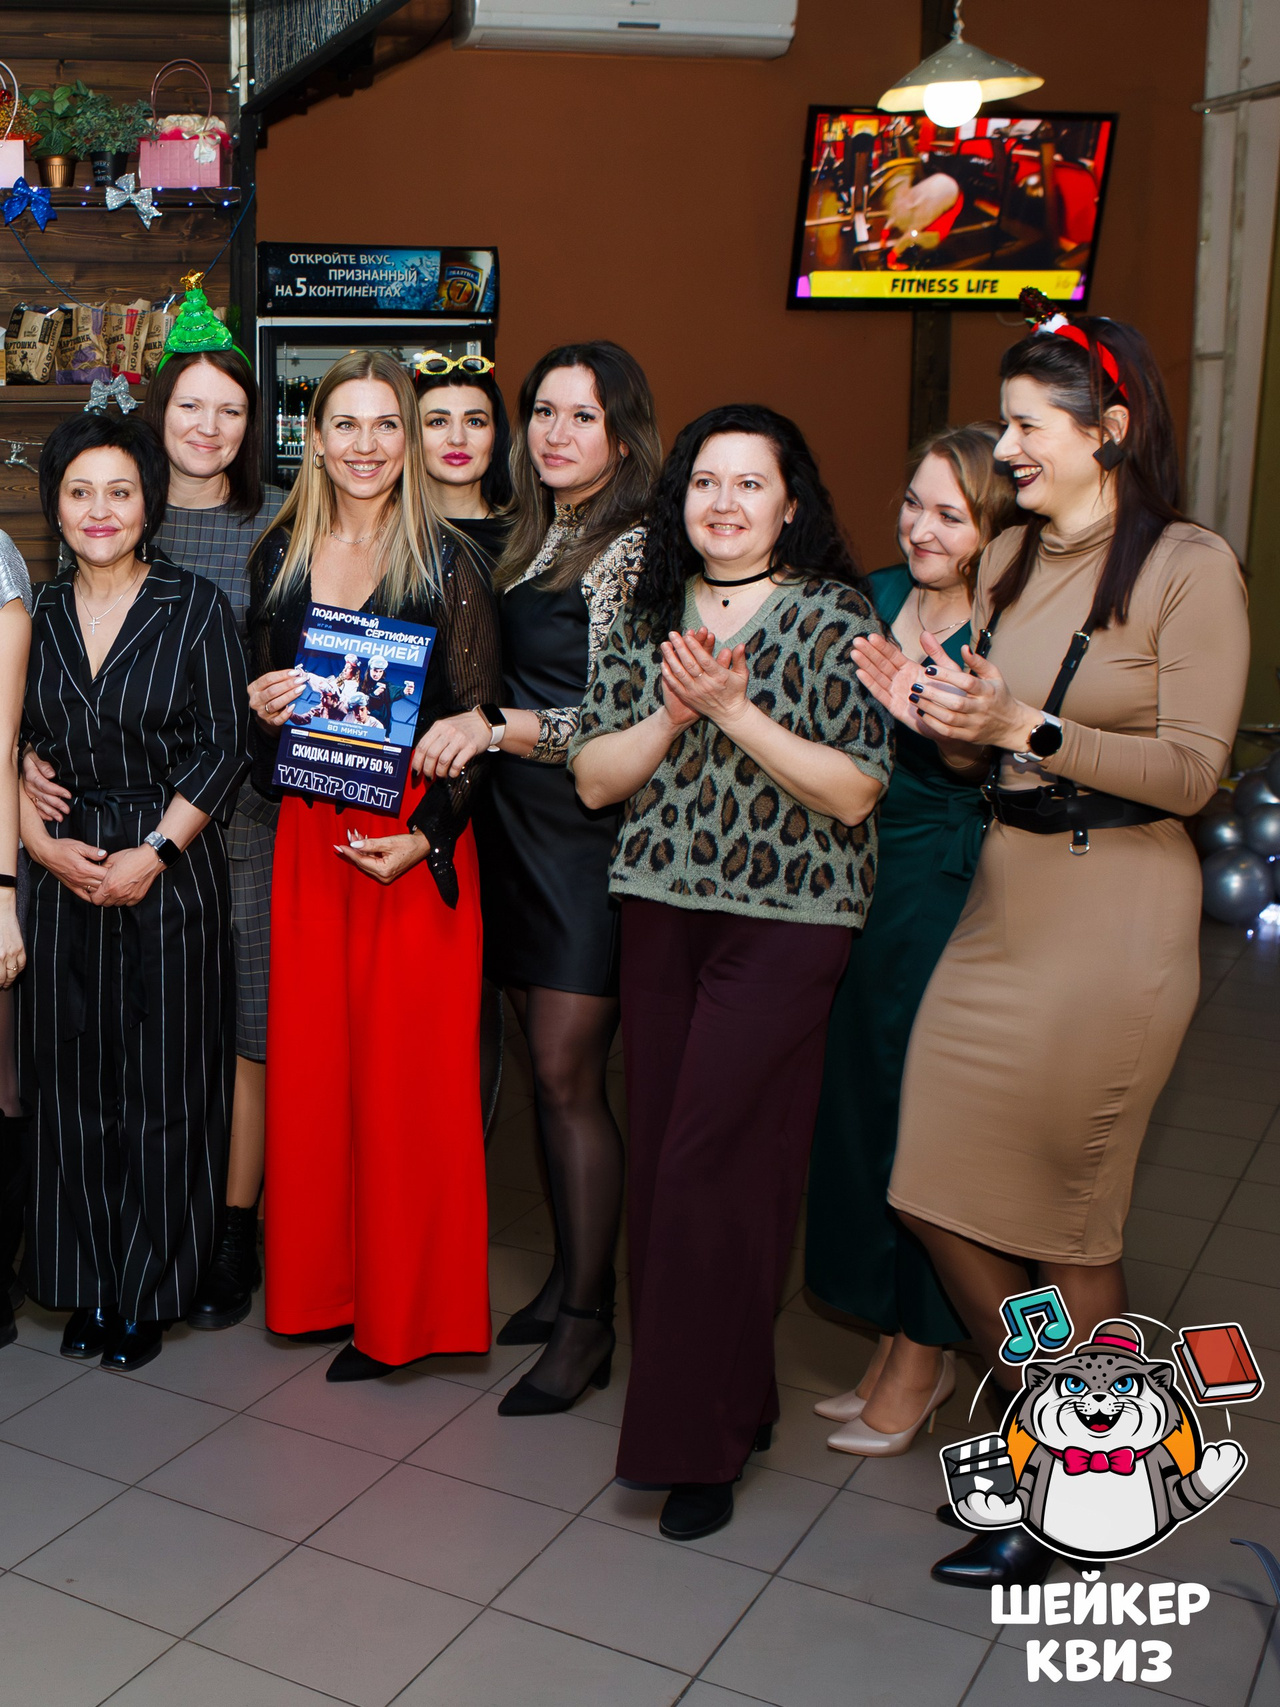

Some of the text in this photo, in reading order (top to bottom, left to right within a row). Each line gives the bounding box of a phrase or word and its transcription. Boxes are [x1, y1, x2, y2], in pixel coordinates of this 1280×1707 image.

[289, 252, 395, 266] ОТКРОЙТЕ ВКУС,
[328, 267, 418, 282] ПРИЗНАННЫЙ
[275, 277, 402, 297] НА 5 КОНТИНЕНТАХ
[456, 281, 468, 300] 7
[891, 278, 999, 294] FITNESS LIFE
[312, 607, 379, 629] ПОДАРОЧНЫЙ
[311, 632, 420, 662] КОМПАНИЕЙ
[365, 628, 431, 647] СЕРТИФИКАТ
[340, 727, 368, 737] МИНУТ
[292, 743, 394, 775] СКИДКА НА ИГРУ 50 %
